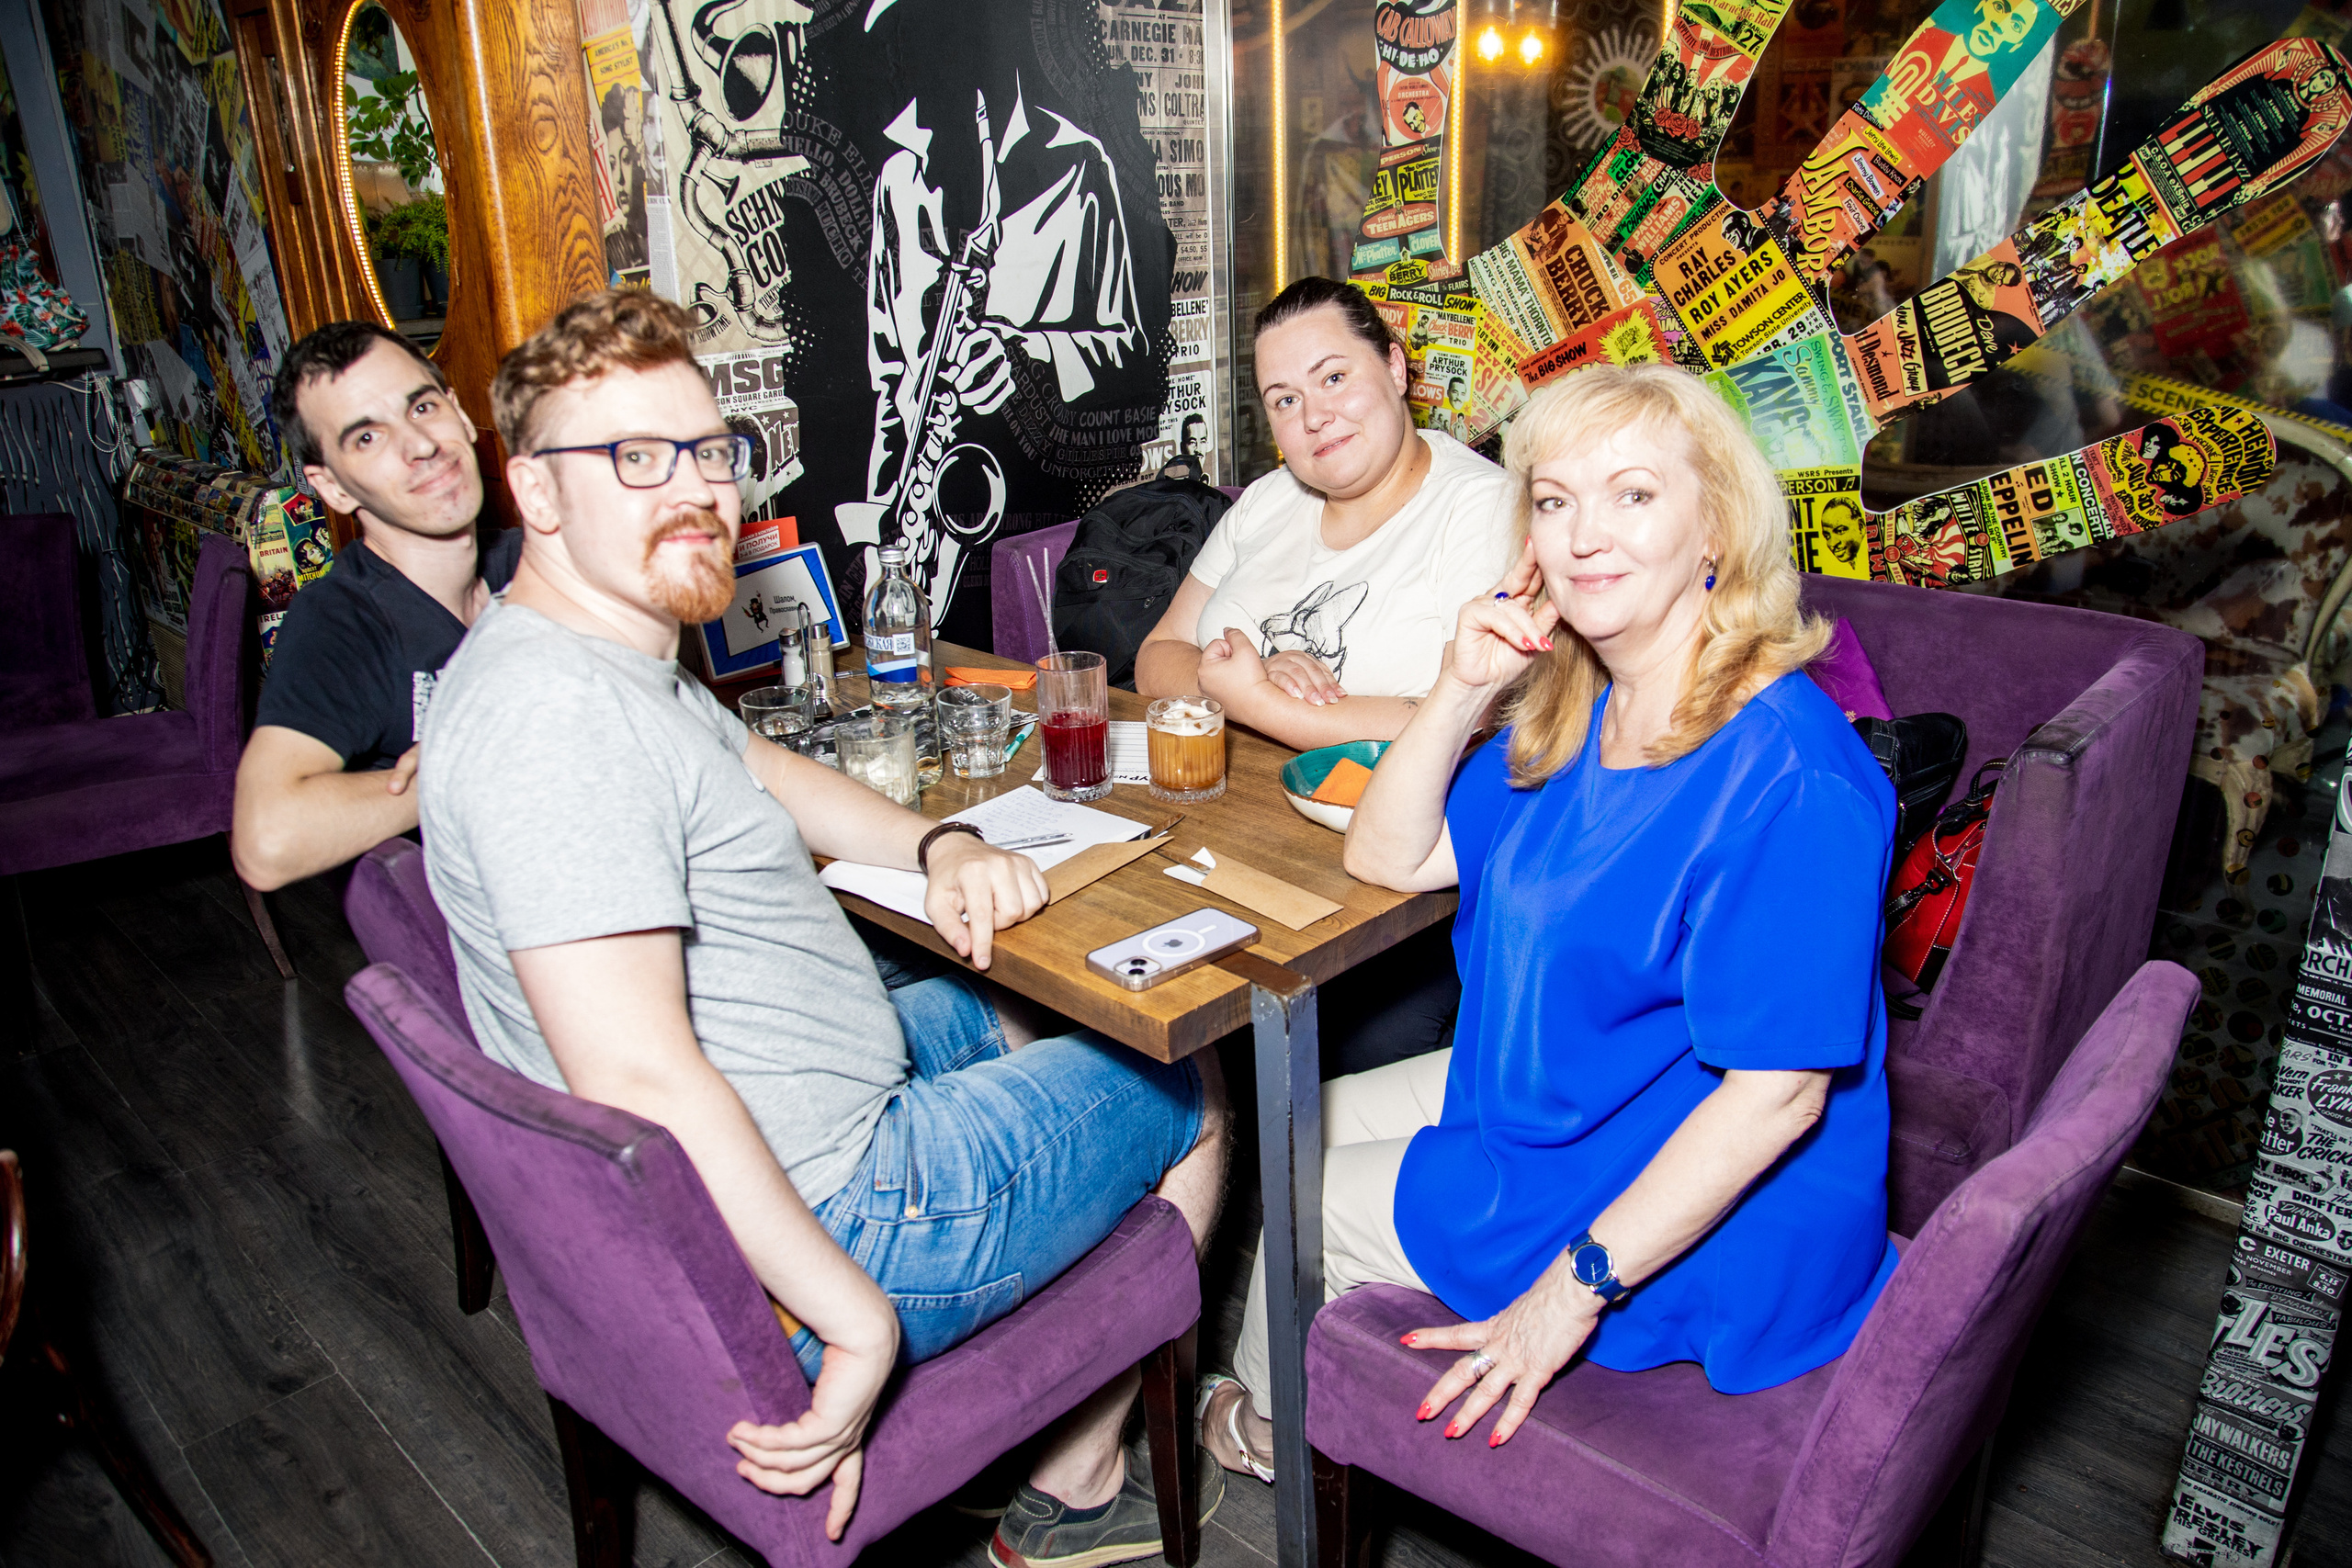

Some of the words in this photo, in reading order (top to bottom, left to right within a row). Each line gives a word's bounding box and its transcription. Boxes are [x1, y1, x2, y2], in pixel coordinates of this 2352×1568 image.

[1377, 6, 1401, 42] CAB
[1399, 6, 1456, 49] CALLOWAY
[1713, 0, 1755, 22] Carnegie
[1754, 12, 1777, 29] Hall
[1747, 20, 1769, 39] MARCH
[1099, 20, 1176, 44] CARNEGIE
[1676, 20, 1699, 49] APPETITE
[1700, 39, 1712, 52] FOR
[1736, 28, 1765, 53] 27
[598, 64, 613, 76] SONG
[613, 56, 634, 72] STYLIST
[1131, 46, 1158, 62] DEC.
[1161, 49, 1175, 63] 31
[1915, 82, 1973, 145] DAVIS
[1930, 68, 1986, 130] MILES
[782, 110, 842, 147] DUKE
[1851, 102, 1864, 115] Fats
[1862, 110, 1883, 130] Domino
[1380, 147, 1421, 165] PERSON
[1586, 150, 1606, 175] RHYTHM
[1865, 130, 1880, 144] Jerry
[1877, 141, 1886, 152] Lee
[1884, 148, 1899, 164] Lewis
[1595, 154, 1614, 181] STAGE
[1675, 172, 1689, 187] THE
[1854, 156, 1868, 178] Jimmy
[1865, 174, 1881, 197] Bowen
[1872, 155, 1891, 175] Buddy
[1888, 171, 1904, 186] Knox
[837, 168, 873, 235] DOLLY!
[1586, 182, 1601, 206] FAYE
[1589, 188, 1612, 219] ADAMS
[1846, 180, 1863, 201] Charlie
[1861, 197, 1880, 217] Gracie
[820, 172, 864, 254] BRUBECK
[1594, 220, 1608, 235] BIG
[1611, 197, 1625, 217] JOE
[1595, 204, 1610, 221] BO
[1600, 201, 1632, 241] TURNER
[1626, 192, 1656, 234] CHARMS
[1634, 210, 1657, 242] PAUL
[1635, 197, 1681, 253] WILLIAMS
[1844, 198, 1855, 216] Four
[1852, 213, 1866, 231] Coins
[814, 201, 854, 270] MUCHO
[1649, 233, 1664, 251] BIG
[1663, 209, 1684, 234] BAND
[1659, 240, 1689, 266] CONCERT
[1689, 203, 1732, 241] PRODUCTION
[1498, 240, 1510, 259] BIG
[1676, 242, 1699, 262] PRESENTS
[1678, 246, 1711, 280] RAY
[1389, 266, 1426, 282] BERRY
[1565, 244, 1611, 321] CHUCK
[1673, 250, 1736, 308] CHARLES
[1689, 291, 1721, 325] ROY
[1724, 250, 1773, 299] AYERS
[758, 283, 781, 310] TICKETS
[1368, 285, 1386, 298] BIG
[1444, 297, 1477, 312] SHOW
[1497, 289, 1515, 325] GONE
[1545, 254, 1593, 330] BERRY
[1700, 315, 1728, 342] MISS
[1729, 283, 1770, 319] DAMITA
[1772, 269, 1786, 286] JO
[698, 313, 732, 344] SHOWTIME
[1170, 318, 1209, 343] BERRY
[1428, 319, 1447, 333] Chuck
[1448, 322, 1476, 340] BERRY
[1732, 316, 1772, 352] TOWSON
[1771, 291, 1807, 320] CENTER
[1741, 340, 1764, 357] Towson
[1766, 324, 1781, 341] State
[1781, 300, 1812, 327] University
[1787, 320, 1807, 341] 29
[1918, 280, 1988, 385] BRUBECK
[1976, 314, 1998, 355] Dave
[1449, 338, 1467, 346] TRIO
[1430, 364, 1467, 377] PRYSOCK
[1432, 356, 1465, 367] ARTHUR
[1476, 343, 1514, 382] ELVIS
[1524, 371, 1539, 384] The
[1538, 358, 1555, 378] BIG
[1555, 341, 1588, 368] SHOW
[1782, 344, 1824, 406] Sammy
[1859, 331, 1900, 402] Desmond
[1903, 362, 1923, 392] Group
[733, 393, 762, 404] SQUARE
[1006, 345, 1051, 427] STARDUST
[1049, 423, 1069, 444] THE
[1071, 430, 1099, 446] MAN
[1106, 429, 1133, 444] LOVE
[1811, 340, 1828, 383] SWING
[1823, 394, 1846, 433] SWAY
[1041, 382, 1078, 427] CROSBY
[1079, 410, 1119, 428] COUNT
[1125, 406, 1156, 424] BASIE
[1017, 403, 1055, 457] DIZZY
[1057, 446, 1125, 463] GILLESPIE
[1017, 436, 1038, 461] YOU
[2179, 418, 2194, 437] SOFT
[2192, 435, 2222, 463] MACHINE
[2186, 407, 2244, 496] EXPERIENCE
[1824, 467, 1854, 477] Presents
[2048, 463, 2062, 489] SHOW
[2126, 461, 2147, 492] JULY
[2064, 480, 2076, 503] HOUR
[2075, 467, 2106, 539] CONCERT!
[1950, 491, 1979, 537] WHITE
[2115, 491, 2133, 515] BATON
[2131, 510, 2160, 532] ROUGE
[259, 547, 288, 558] BRITAIN
[739, 544, 746, 552] И
[746, 533, 779, 550] ПОЛУЧИ
[752, 541, 779, 554] ПОДАРОК
[1994, 525, 2008, 559] COUNTRY
[298, 570, 327, 582] MITCHUM
[774, 595, 797, 604] Шалом,
[2297, 983, 2346, 1006] MEMORIAL
[2307, 1005, 2352, 1029] OCT.
[2327, 1052, 2344, 1064] IN
[2306, 1133, 2336, 1148] THE
[2273, 1164, 2310, 1186] BROS.
[2330, 1193, 2352, 1206] The
[2267, 1207, 2296, 1228] Paul
[2296, 1218, 2332, 1241] Anka
[2256, 1225, 2269, 1236] his
[2272, 1232, 2290, 1244] BIG
[2292, 1237, 2352, 1265] ORCHESTRA
[2264, 1245, 2311, 1271] EXETER
[2246, 1255, 2292, 1276] NOVEMBER
[2250, 1264, 2277, 1277] presents
[2319, 1273, 2339, 1286] 6.15
[2312, 1280, 2335, 1295] 8.30
[2270, 1293, 2330, 1318] DYNAMIC!
[2274, 1314, 2336, 1330] FABULOUS!
[2228, 1373, 2261, 1389] DOUBLE
[2199, 1369, 2312, 1425] Brothers
[2192, 1413, 2291, 1470] JAYWALKERS
[2184, 1460, 2260, 1497] BERRY
[2191, 1440, 2217, 1464] THE
[2216, 1453, 2284, 1496] KESTRELS
[2178, 1492, 2246, 1534] ELVIS
[2193, 1484, 2229, 1504] DRAMATIC
[2228, 1501, 2257, 1518] SINGING
[2257, 1514, 2280, 1527] ROLE!
[2173, 1516, 2193, 1529] HIS
[2198, 1527, 2257, 1560] GREATEST
